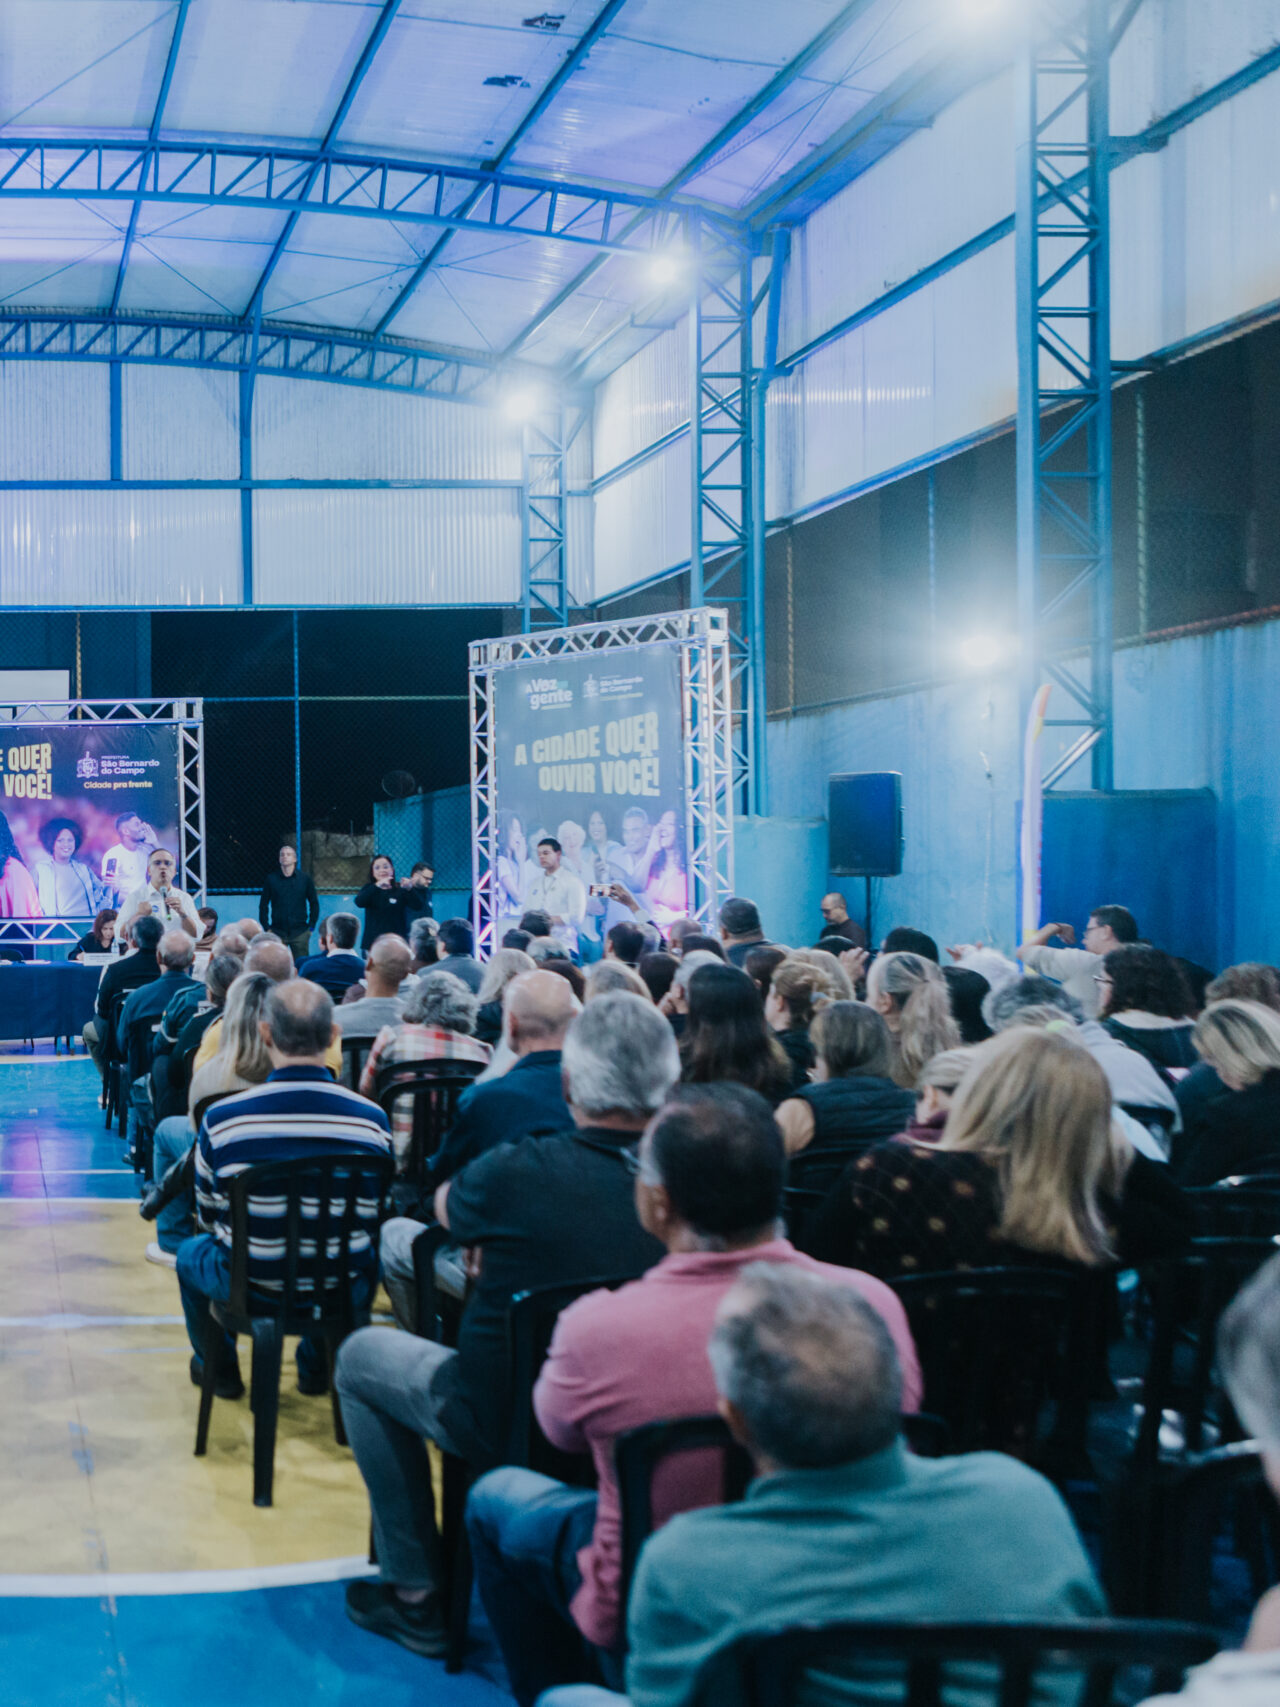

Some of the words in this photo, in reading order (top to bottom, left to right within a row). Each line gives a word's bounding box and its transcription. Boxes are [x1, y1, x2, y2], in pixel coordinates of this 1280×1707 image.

[530, 689, 573, 710] gente
[515, 744, 528, 766] A
[532, 725, 600, 764] CIDADE
[605, 711, 659, 757] QUER
[8, 743, 52, 772] QUER
[119, 759, 160, 767] Bernardo
[3, 766, 53, 800] VOCÊ!
[101, 767, 113, 775] do
[114, 767, 145, 776] Campo
[539, 763, 596, 793] OUVIR
[600, 750, 660, 797] VOCÊ!
[113, 782, 127, 790] pra
[128, 780, 153, 788] frente
